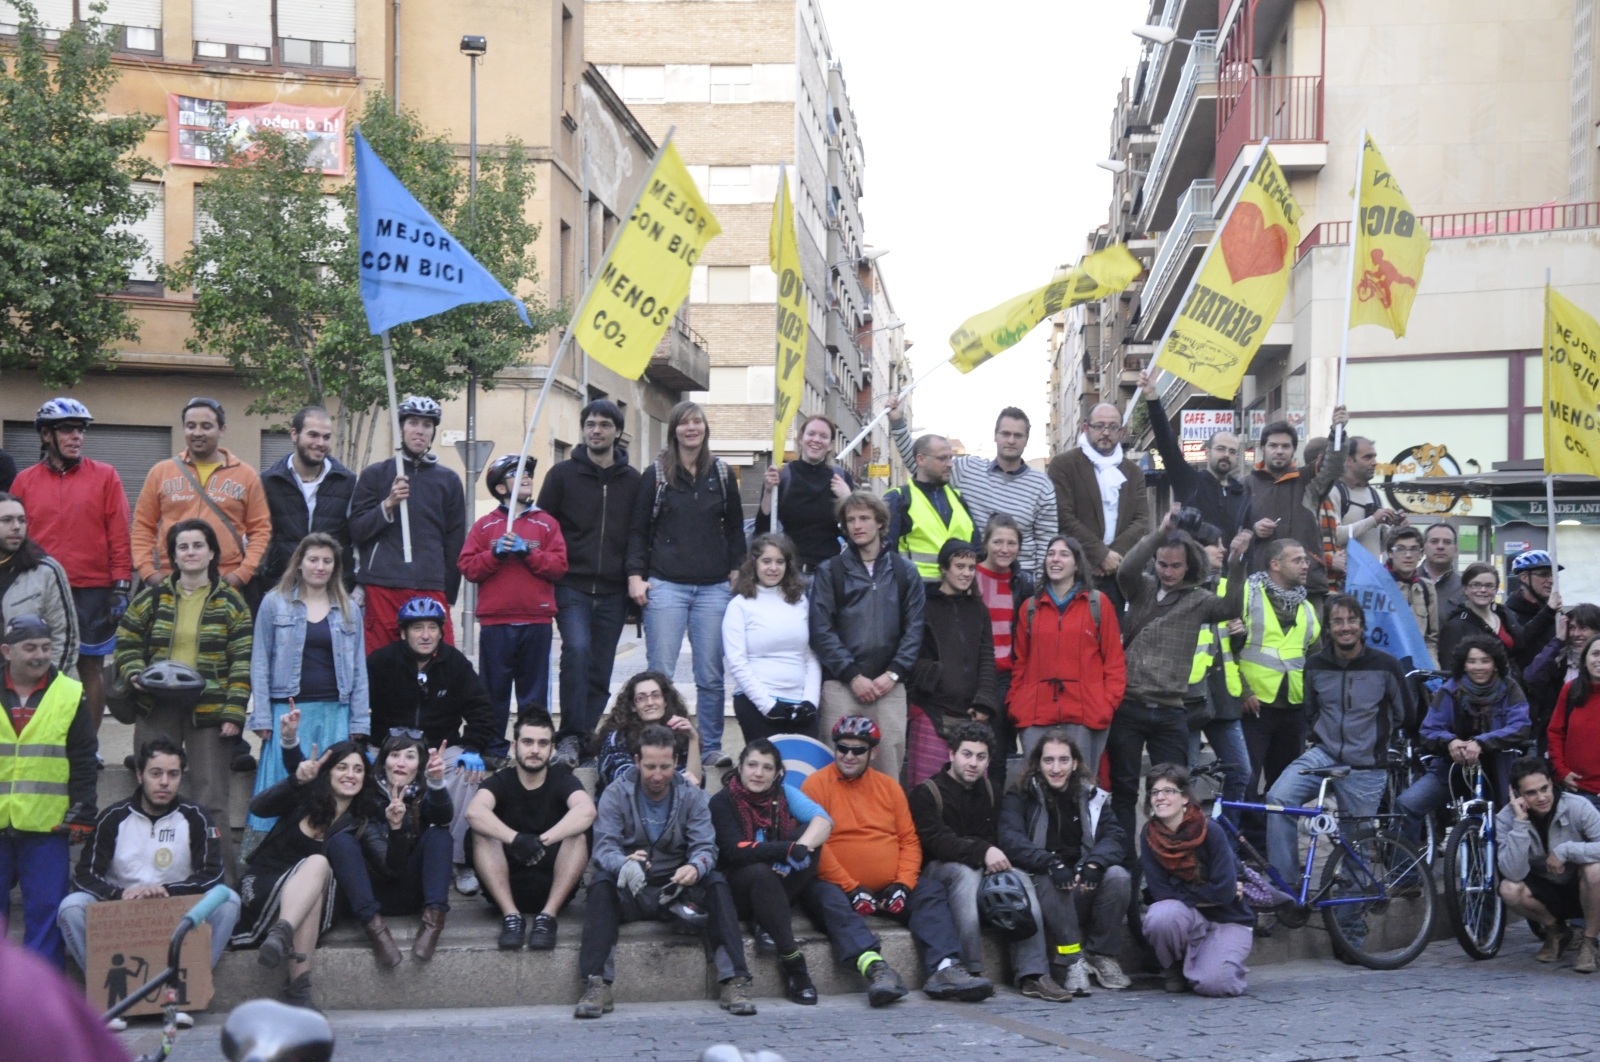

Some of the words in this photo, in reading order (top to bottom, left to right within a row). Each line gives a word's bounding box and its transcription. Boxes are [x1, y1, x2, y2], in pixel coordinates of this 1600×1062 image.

[648, 179, 706, 235] MEJOR
[376, 219, 451, 252] MEJOR
[667, 234, 698, 267] BIC
[361, 251, 409, 273] CON
[419, 258, 463, 284] BICI
[601, 262, 670, 326] MENOS
[1184, 412, 1206, 424] CAFE
[1215, 412, 1232, 424] BAR
[208, 475, 246, 500] LAW
[1553, 502, 1600, 514] DELANT
[1365, 626, 1390, 646] O2
